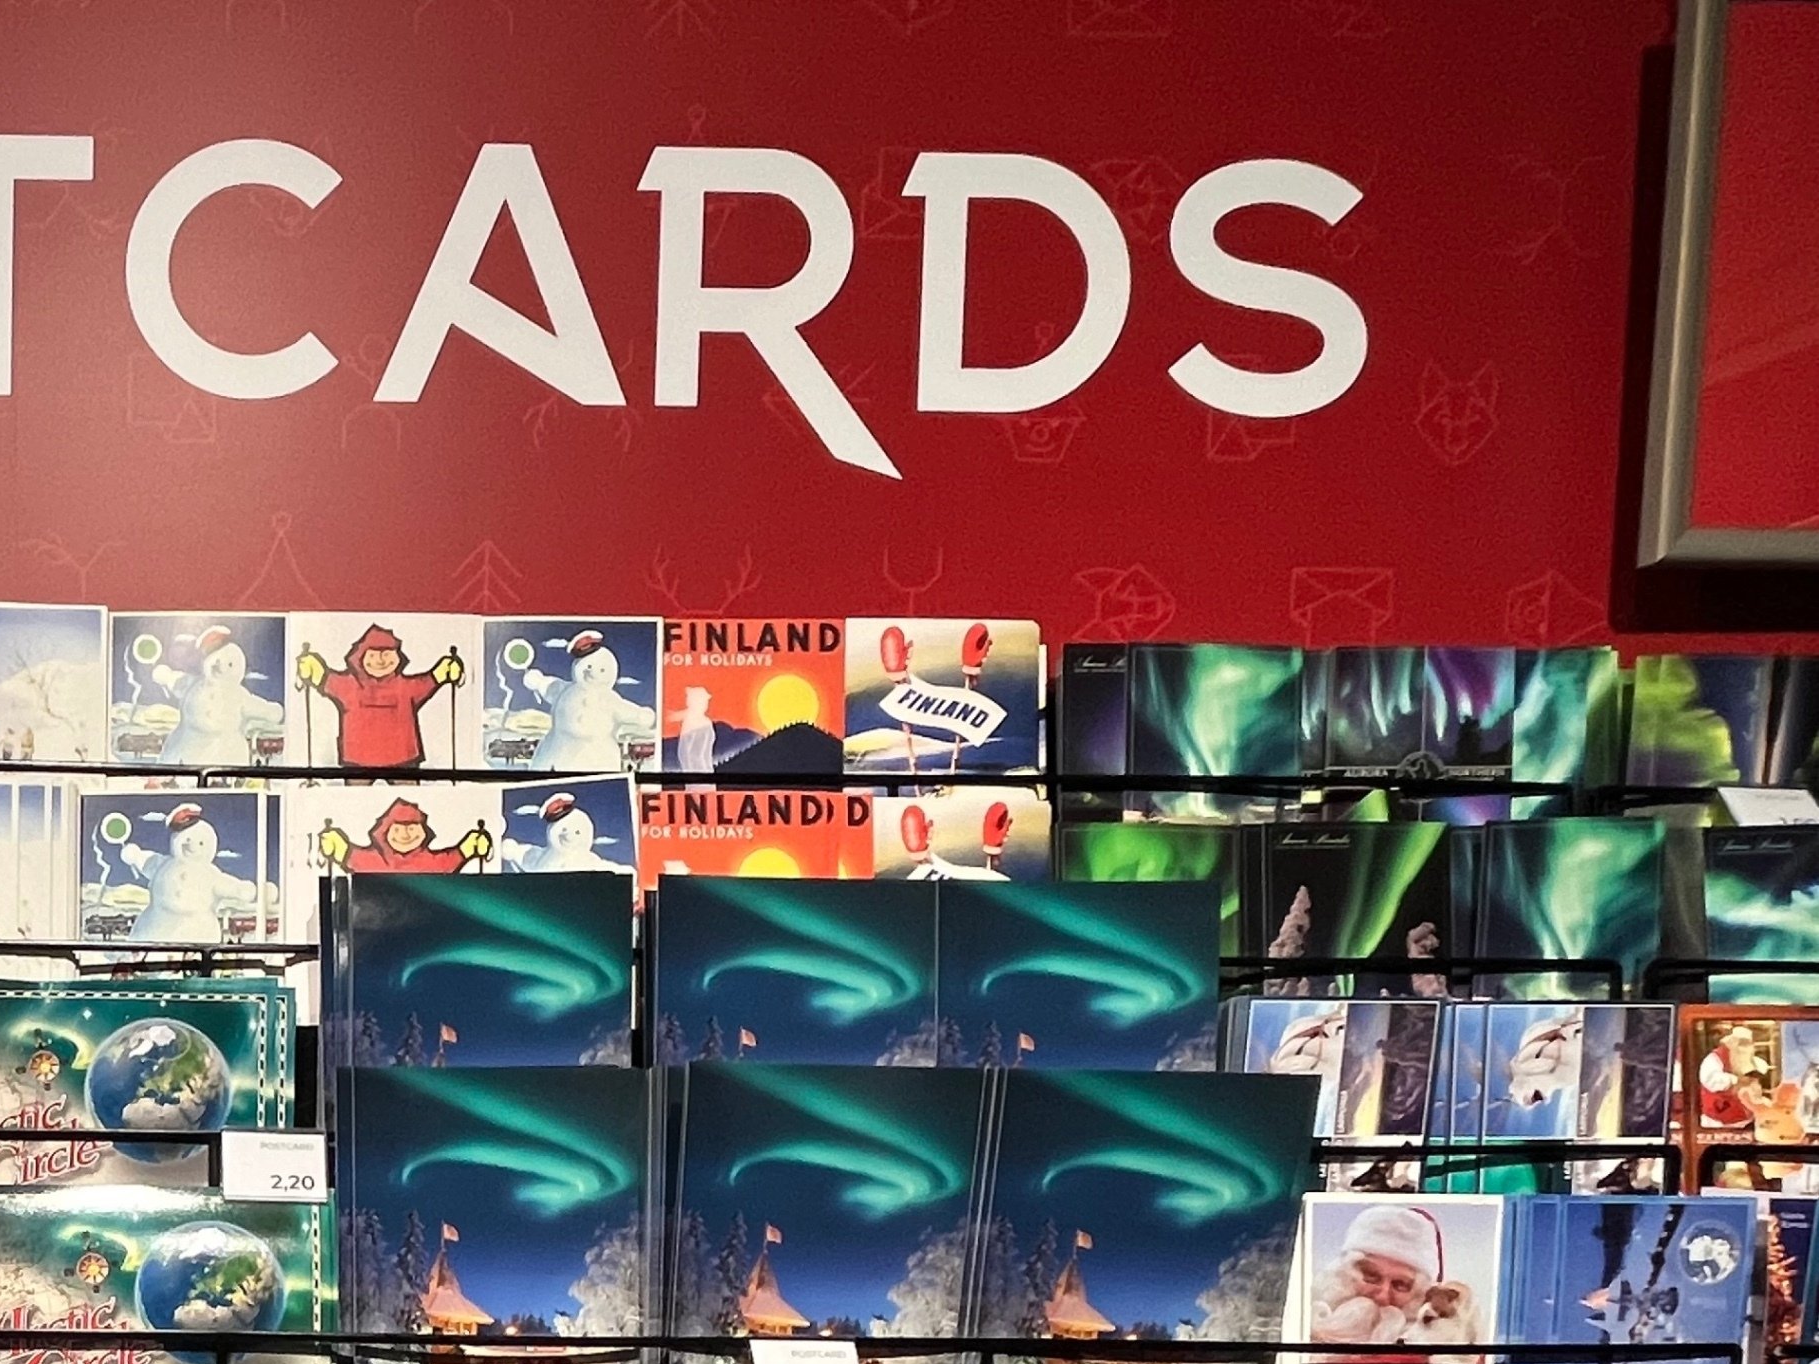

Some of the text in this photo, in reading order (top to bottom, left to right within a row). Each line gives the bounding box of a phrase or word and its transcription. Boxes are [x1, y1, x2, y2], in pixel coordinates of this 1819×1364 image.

[664, 622, 842, 653] FINLAND
[663, 653, 773, 668] FOR HOLIDAYS
[897, 687, 990, 730] FINLAND
[641, 793, 827, 827] FINLAND
[641, 826, 755, 840] FOR HOLIDAYS
[269, 1174, 316, 1193] 2,20
